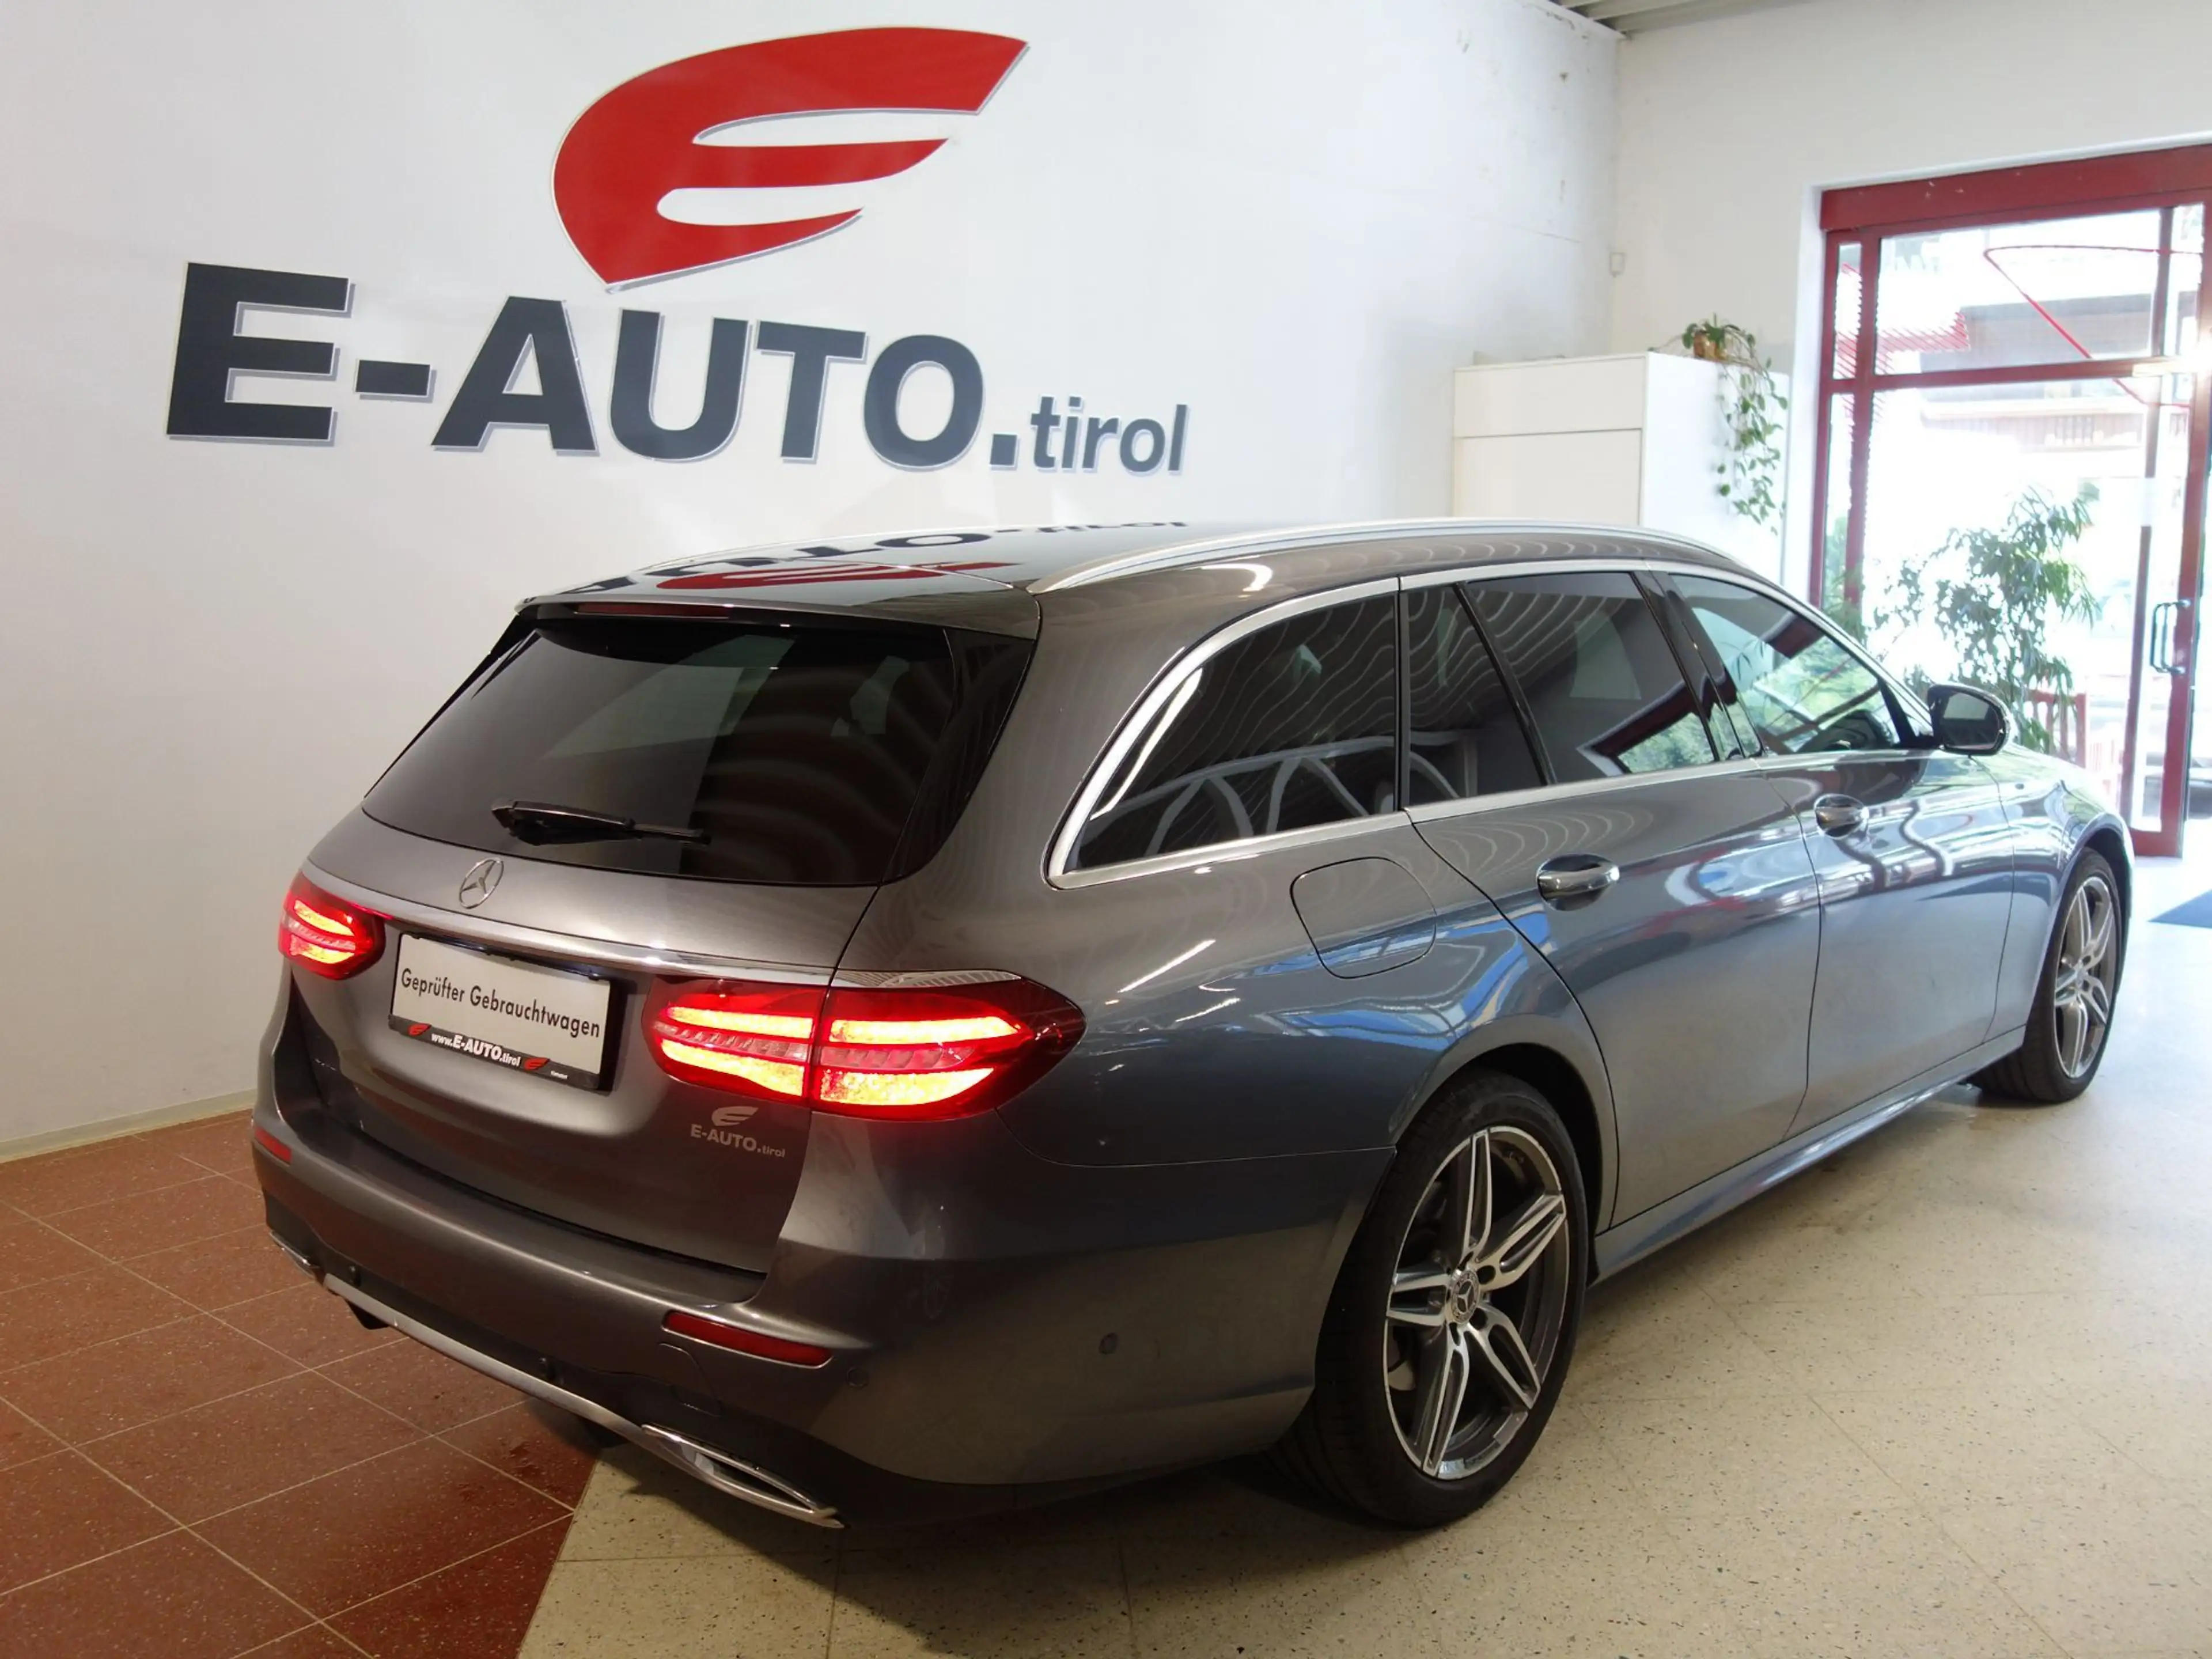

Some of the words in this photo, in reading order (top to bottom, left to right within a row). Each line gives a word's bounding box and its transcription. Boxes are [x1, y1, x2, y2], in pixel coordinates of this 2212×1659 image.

[166, 262, 1188, 473] E-AUTO.tirol
[401, 968, 465, 1002] Geprüfter
[469, 986, 600, 1038] Gebrauchtwagen
[431, 1033, 521, 1067] www.E-AUTO.tirol
[691, 1124, 786, 1158] E-AUTO.tirol
